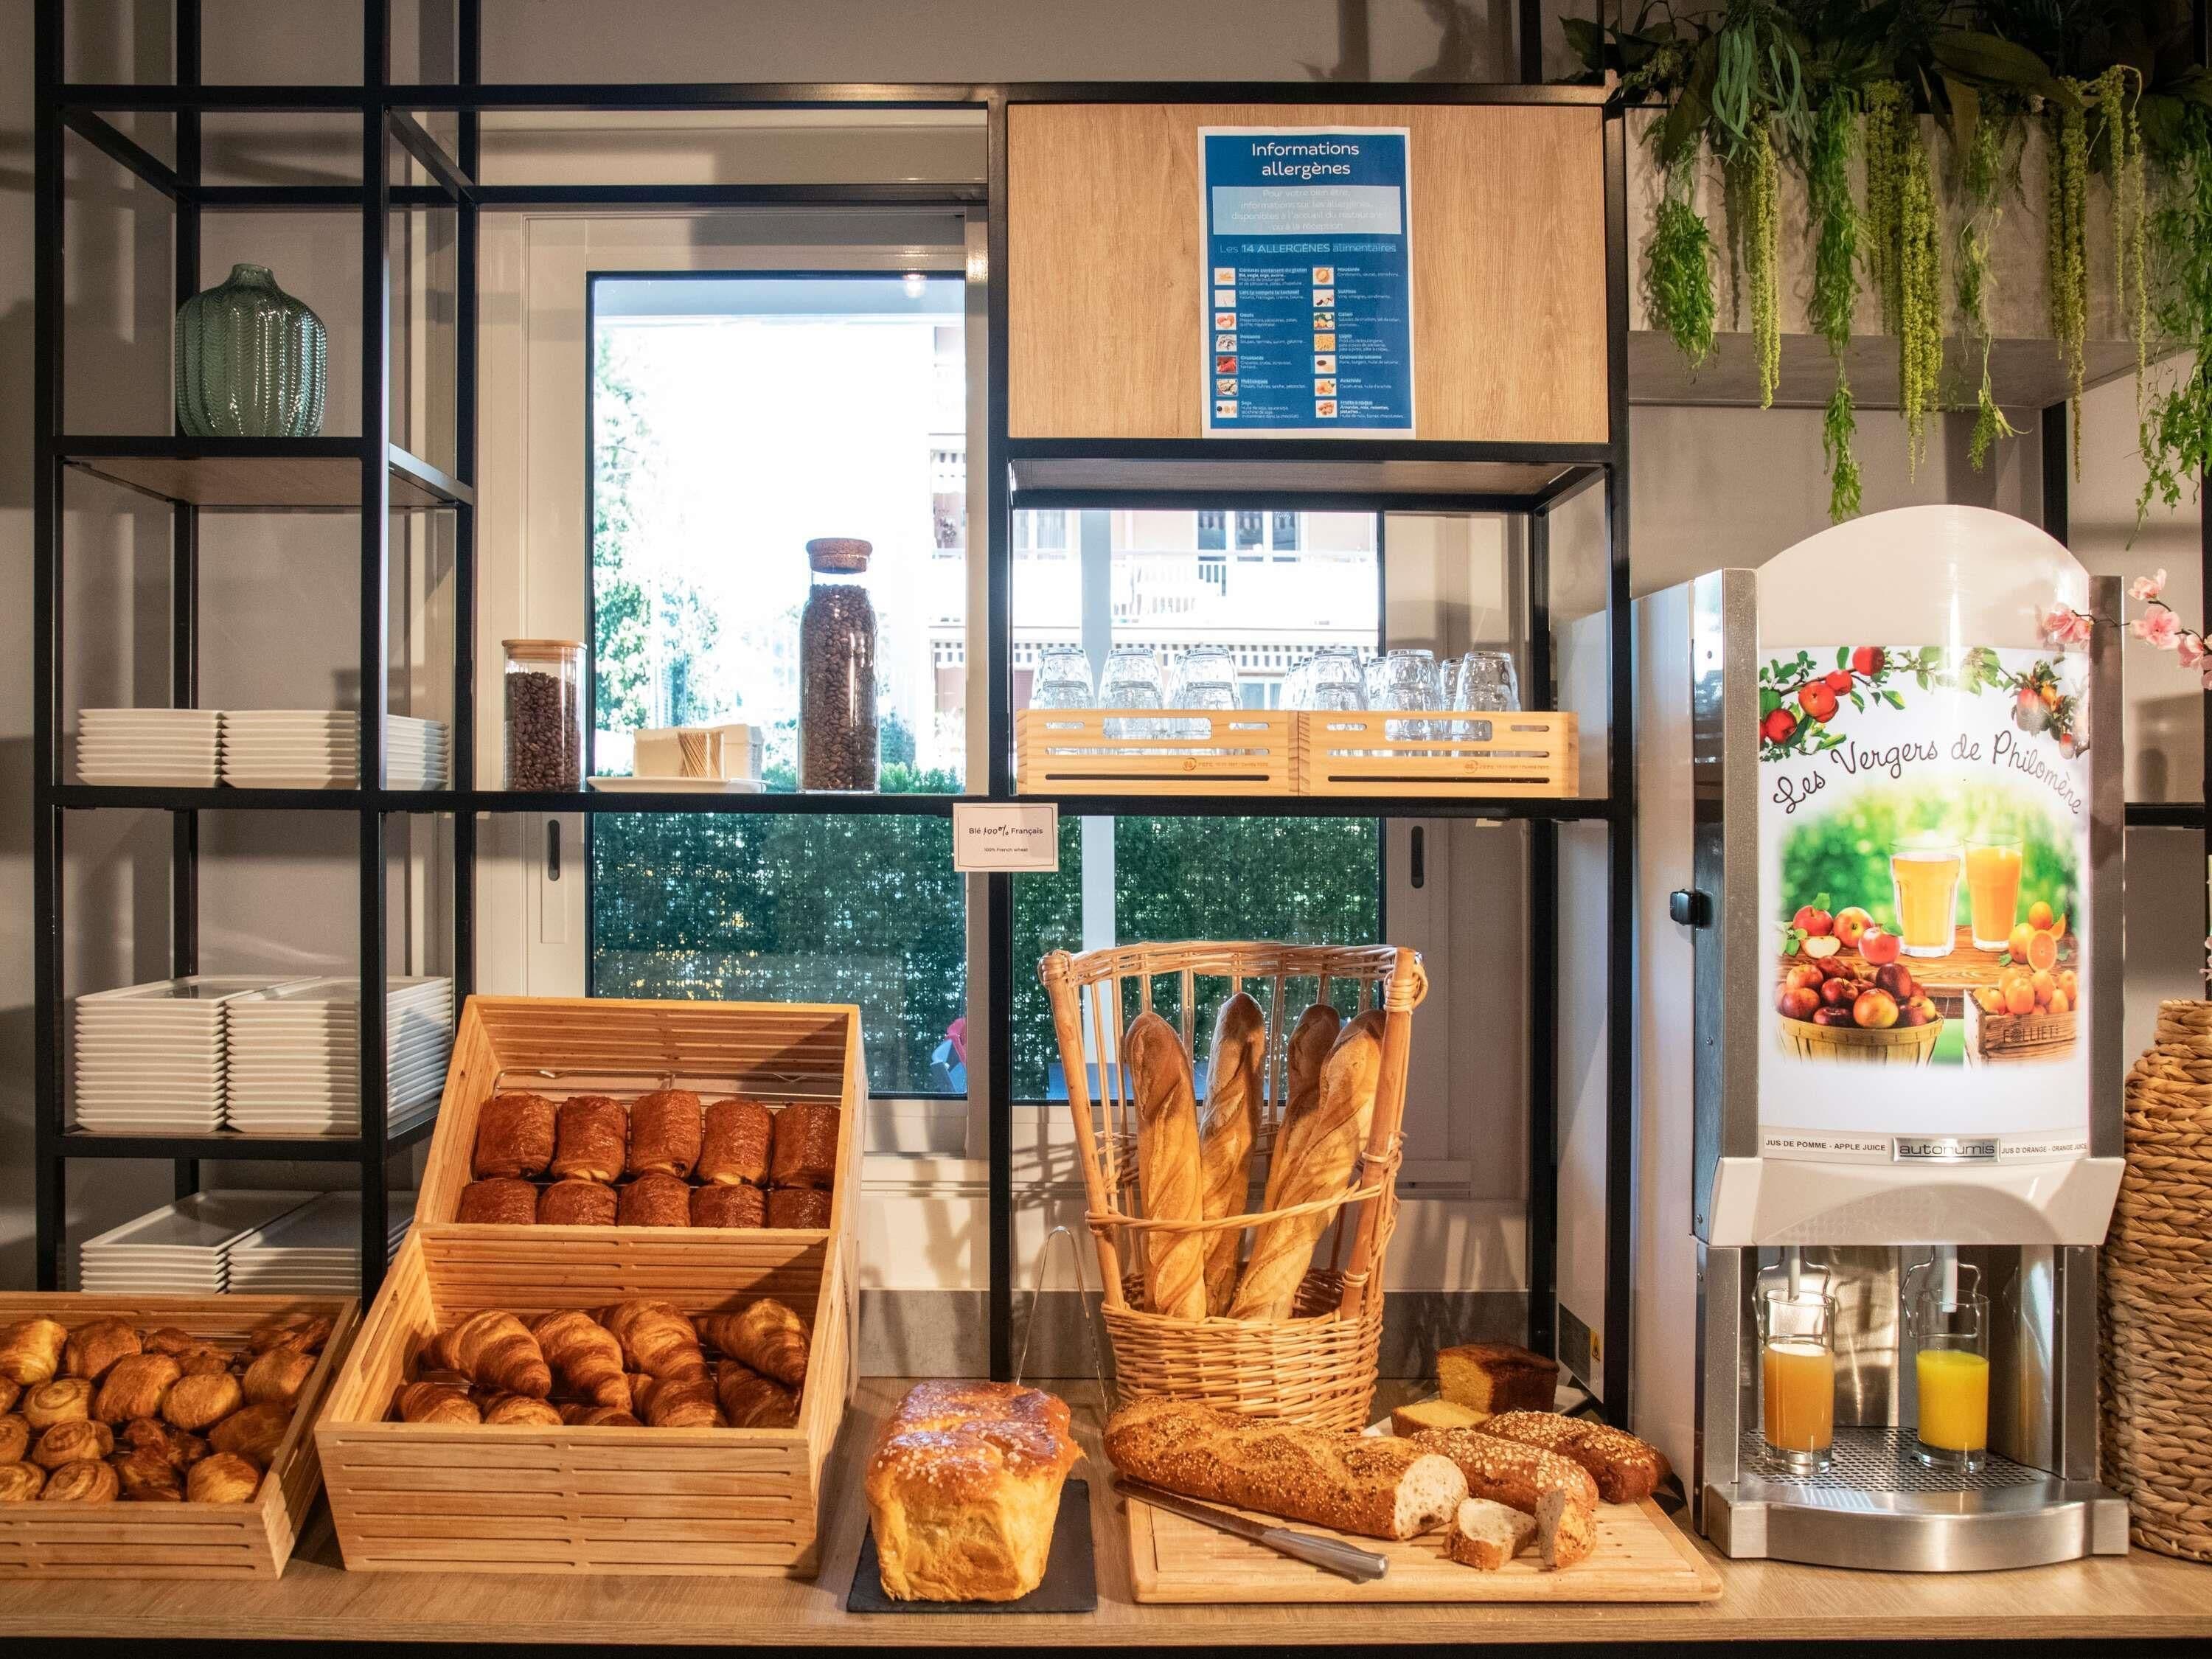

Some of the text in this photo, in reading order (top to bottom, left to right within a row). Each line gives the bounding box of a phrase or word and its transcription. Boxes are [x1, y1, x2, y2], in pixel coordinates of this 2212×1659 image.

[1252, 141, 1360, 156] Informations
[1262, 161, 1351, 180] allergènes
[1220, 245, 1239, 253] Les
[1241, 245, 1254, 253] 14
[1332, 243, 1397, 253] alimentaires
[1773, 729, 2082, 815] Les Vergers de Philomène
[983, 824, 1009, 836] 100%
[1011, 827, 1043, 836] Français
[1899, 1141, 1994, 1155] autonumis
